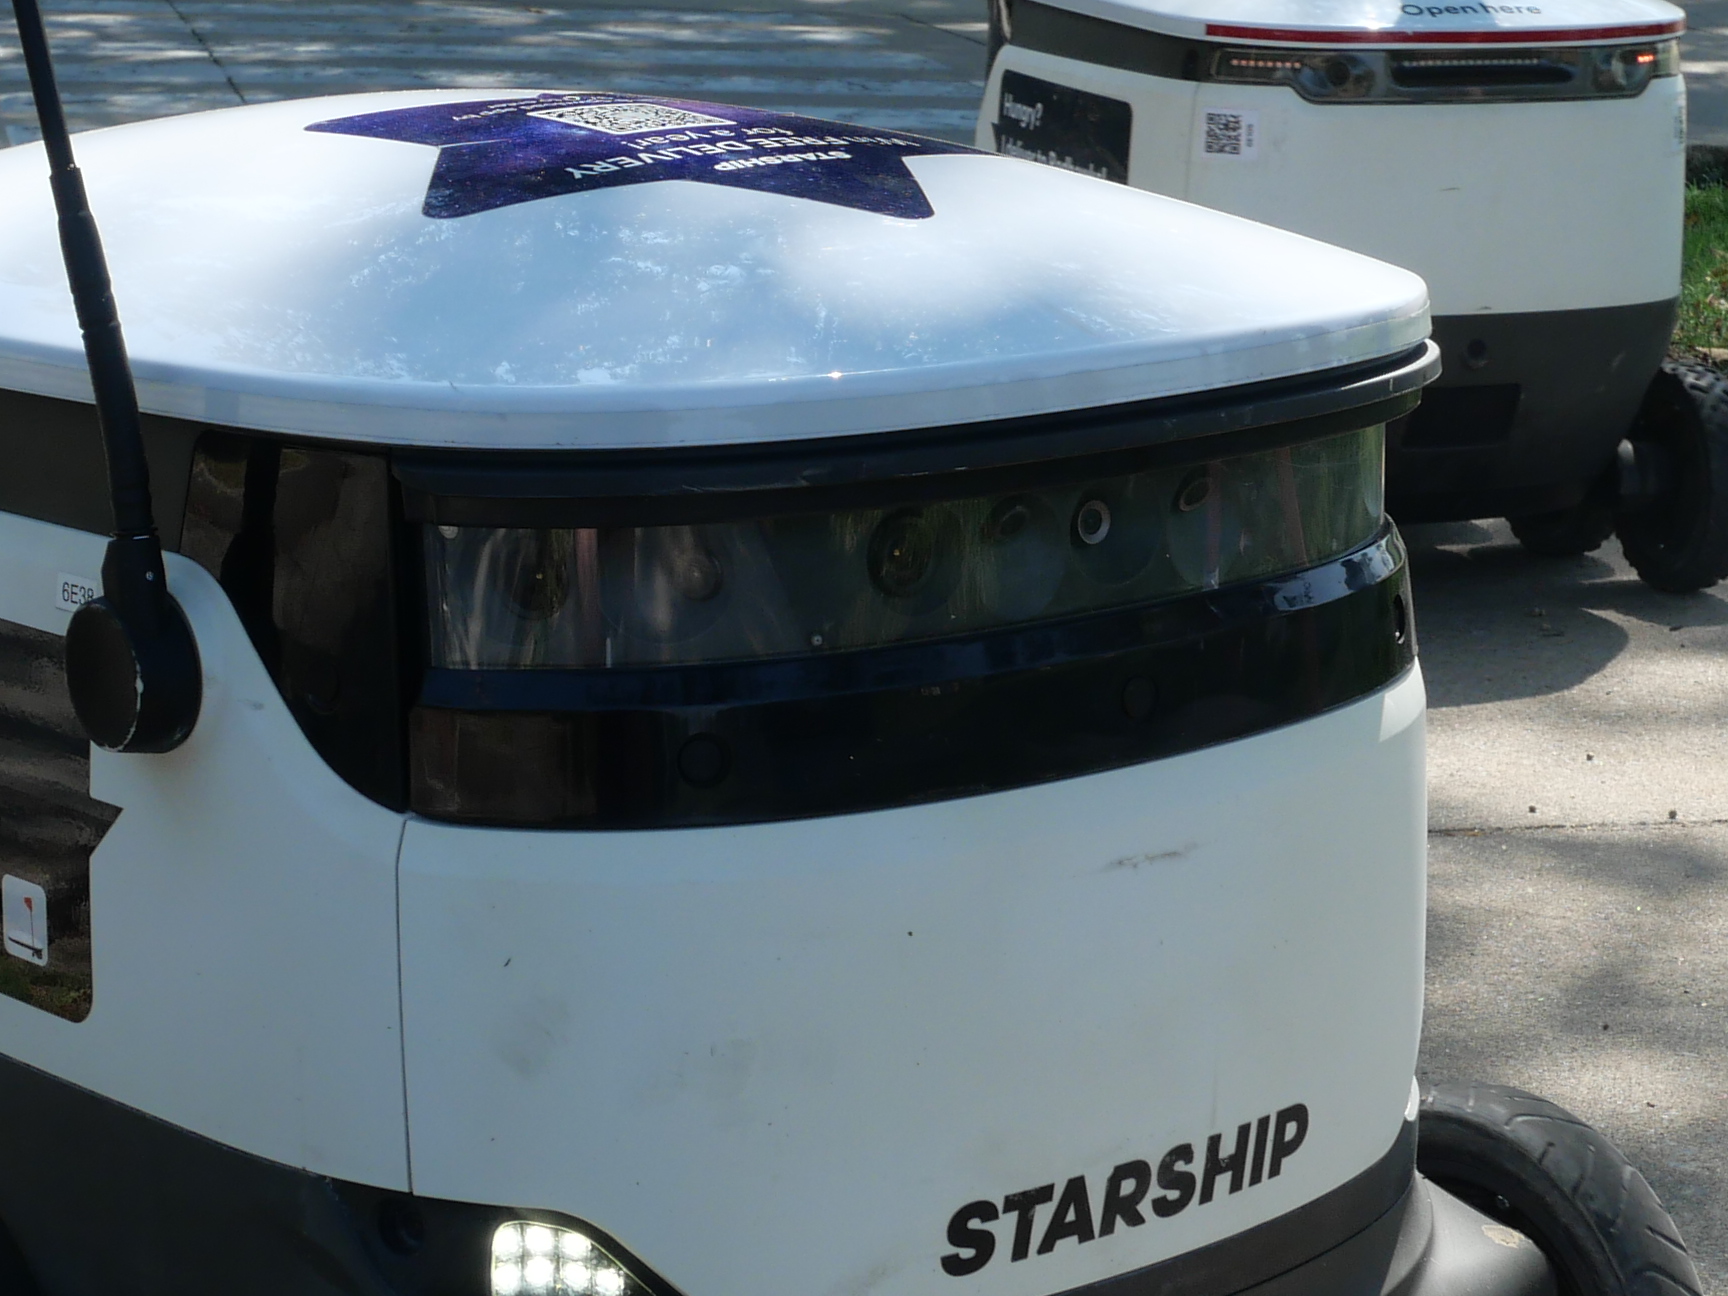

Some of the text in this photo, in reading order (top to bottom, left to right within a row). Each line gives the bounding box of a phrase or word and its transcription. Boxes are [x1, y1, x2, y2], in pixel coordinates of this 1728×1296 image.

[1401, 2, 1542, 18] Open here
[621, 127, 794, 150] for a year!
[745, 135, 850, 149] FREE
[564, 140, 754, 179] DELIVERY
[713, 150, 853, 172] STARSHIP
[939, 1102, 1310, 1278] STARSHIP
